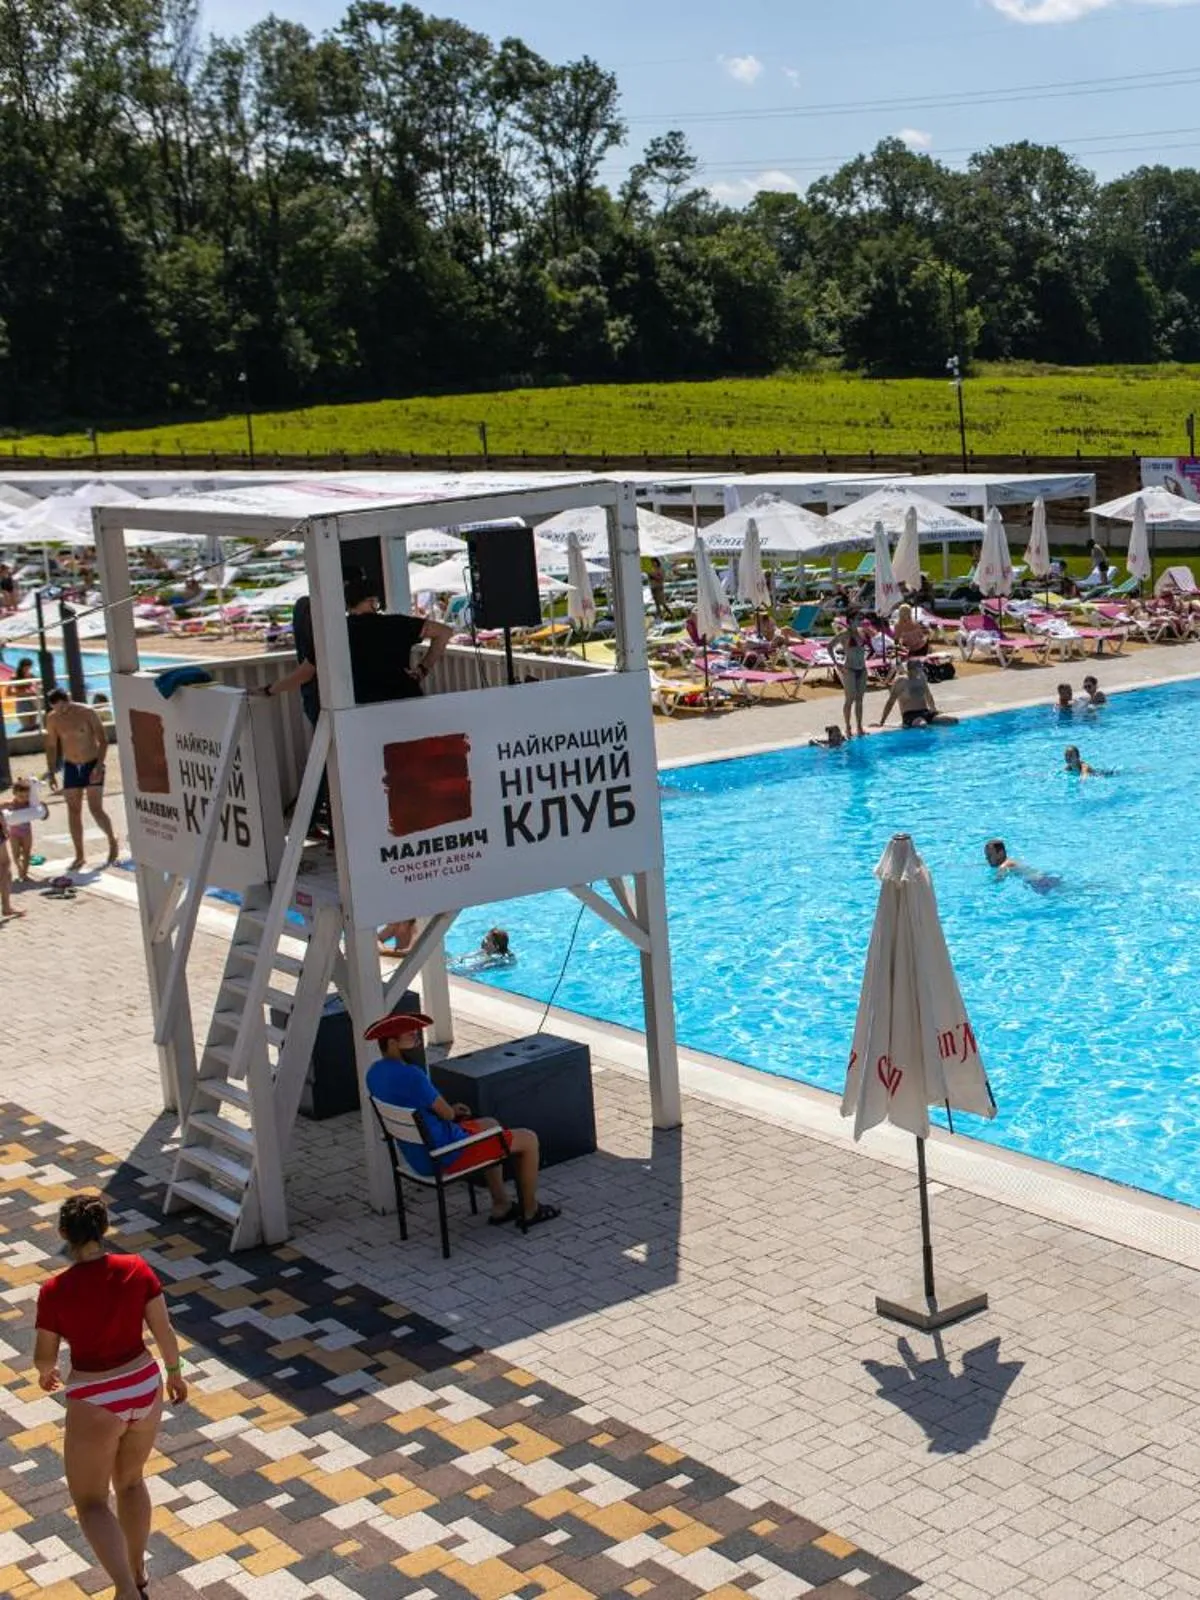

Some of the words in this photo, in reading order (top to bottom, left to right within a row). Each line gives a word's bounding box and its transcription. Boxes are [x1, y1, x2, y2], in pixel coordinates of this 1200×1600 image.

[497, 721, 628, 760] НАЙКРАЩИЙ
[500, 744, 631, 798] НІЧНИЙ
[135, 797, 180, 822] МАЛЕВИЧ
[503, 785, 636, 847] КЛУБ
[380, 828, 489, 863] МАЛЕВИЧ
[390, 857, 442, 875] CONCERT
[446, 850, 482, 864] ARENA
[404, 869, 439, 884] NIGHT
[442, 863, 471, 876] CLUB
